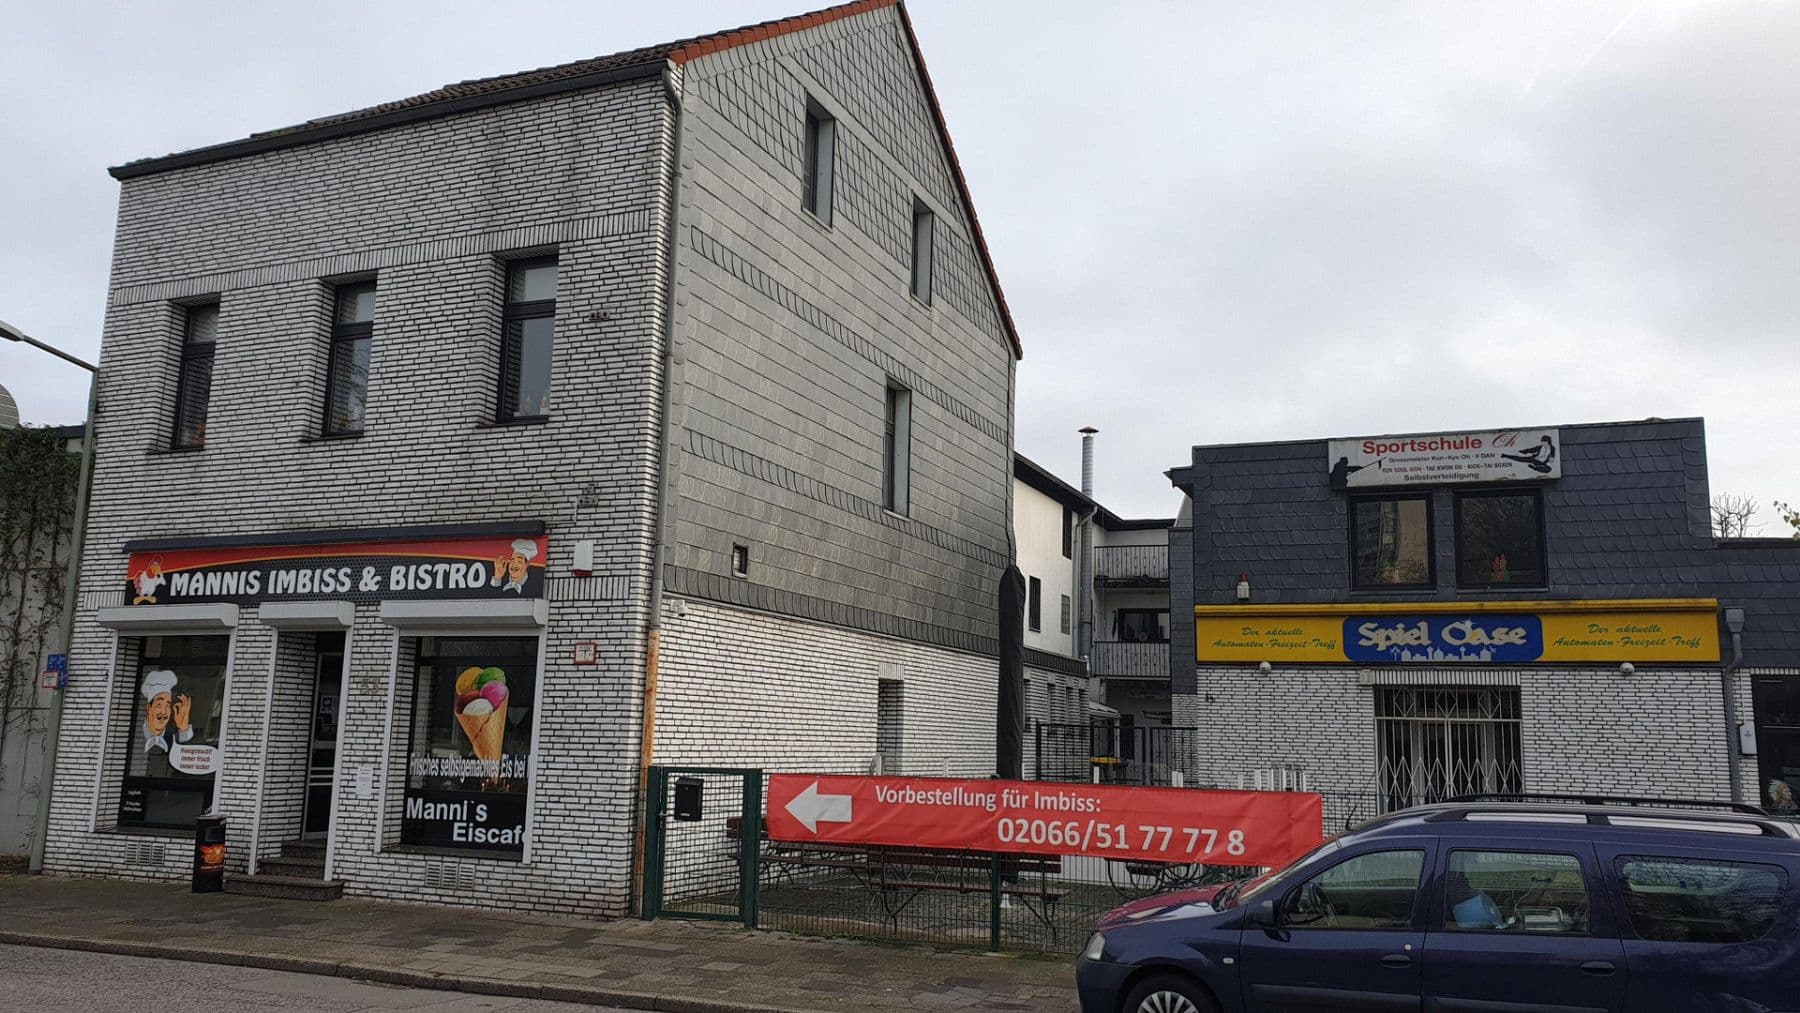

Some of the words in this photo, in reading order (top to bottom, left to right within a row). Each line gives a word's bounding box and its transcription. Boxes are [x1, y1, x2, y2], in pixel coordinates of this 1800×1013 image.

[1362, 436, 1482, 456] Sportschule
[1404, 472, 1480, 481] Selbstverteidigung
[170, 569, 261, 597] MANNIS
[267, 566, 352, 595] IMBISS
[359, 565, 382, 593] &
[388, 562, 487, 591] BISTRO
[1241, 626, 1260, 636] Der
[1265, 626, 1304, 636] aktuelle
[1358, 620, 1432, 651] Spiel
[1441, 620, 1528, 646] Oase
[1587, 623, 1609, 634] Der
[1615, 623, 1662, 633] aktuelle
[501, 753, 513, 778] Eis
[514, 753, 526, 778] bei
[875, 784, 997, 812] Vorbestellung
[1001, 786, 1030, 810] für
[1034, 790, 1102, 814] Imbiss:
[453, 821, 527, 845] Eiscaf
[997, 816, 1130, 852] 02066/51
[1140, 823, 1173, 852] 77
[1182, 827, 1218, 854] 77
[1228, 830, 1246, 856] 8
